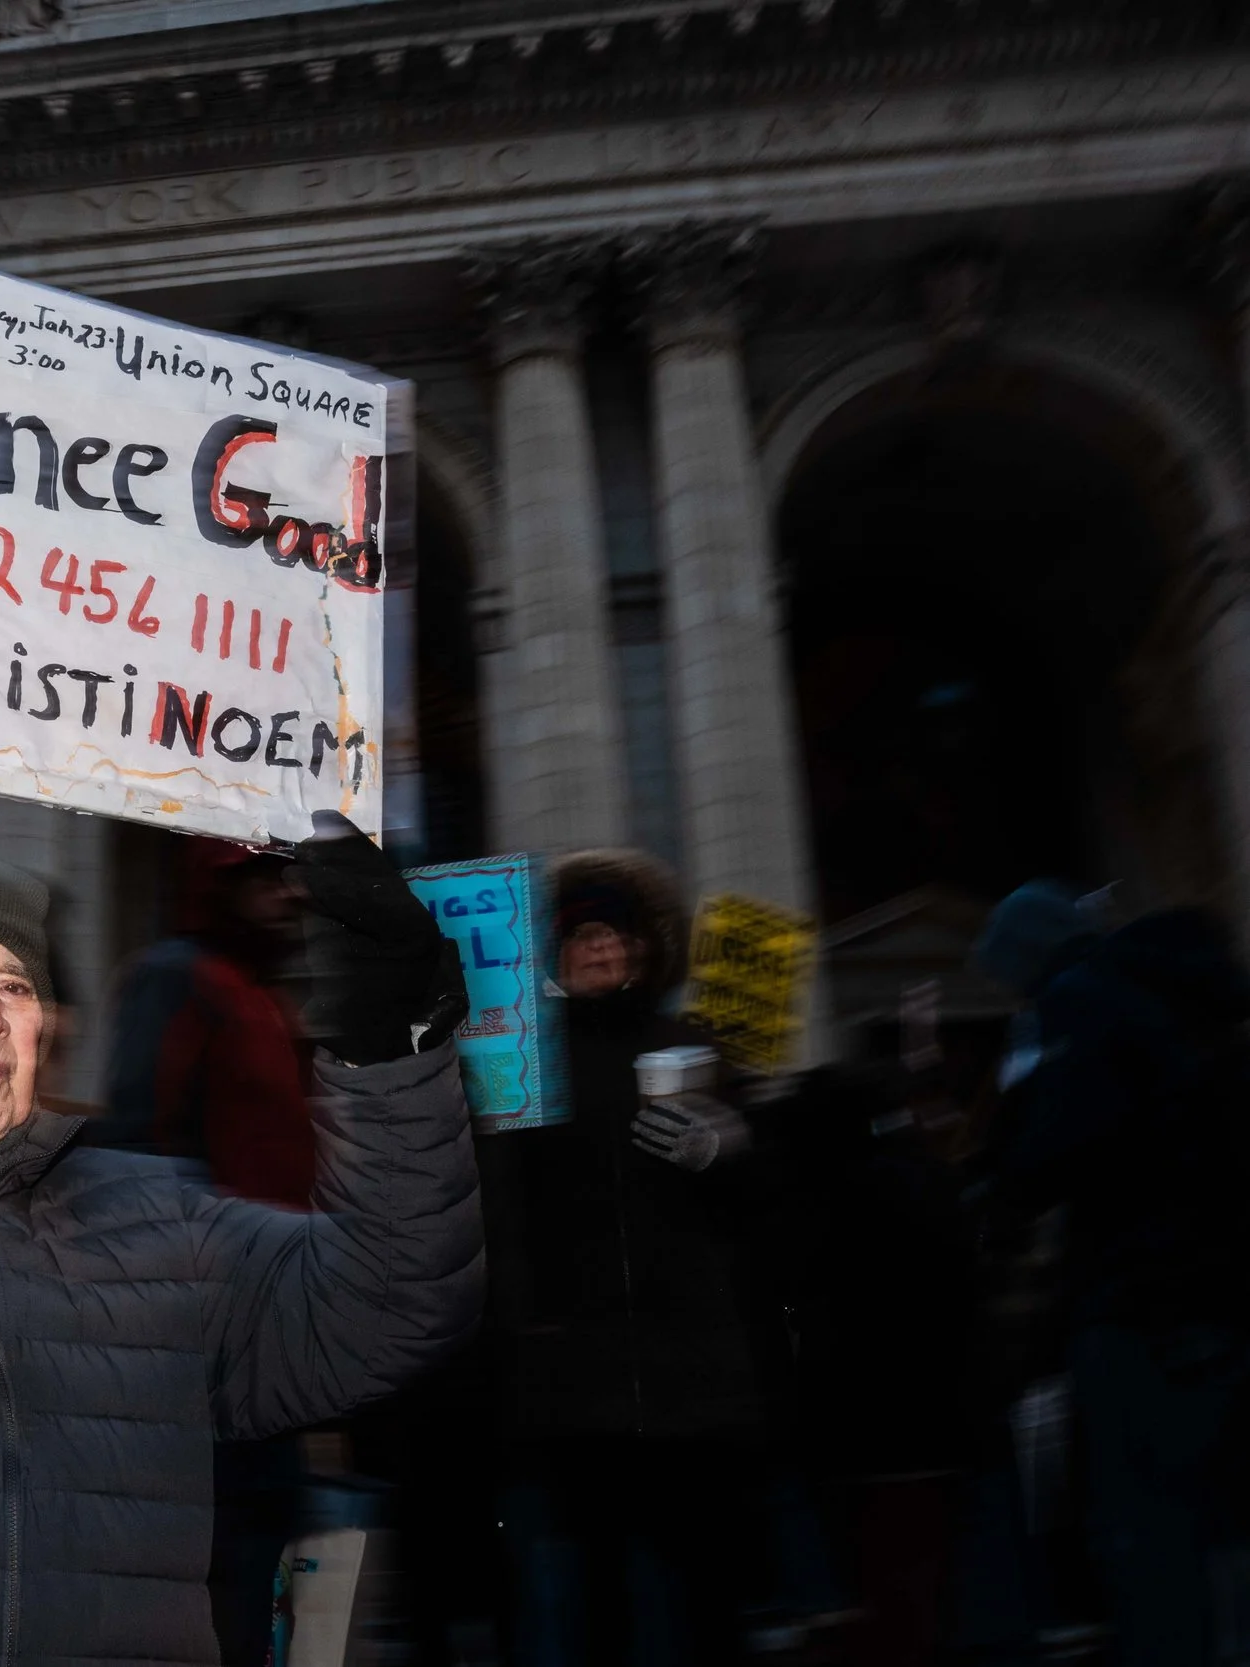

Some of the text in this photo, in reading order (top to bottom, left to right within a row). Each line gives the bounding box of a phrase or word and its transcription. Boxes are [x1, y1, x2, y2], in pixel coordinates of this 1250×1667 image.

[77, 179, 248, 230] YORK
[299, 143, 531, 206] PUBLIC
[8, 345, 66, 371] 3:00
[116, 326, 233, 396] Union
[245, 362, 374, 428] SQUARE
[192, 414, 383, 594] Good
[41, 547, 161, 638] 456
[190, 593, 293, 673] 1111
[149, 681, 366, 794] NOEM
